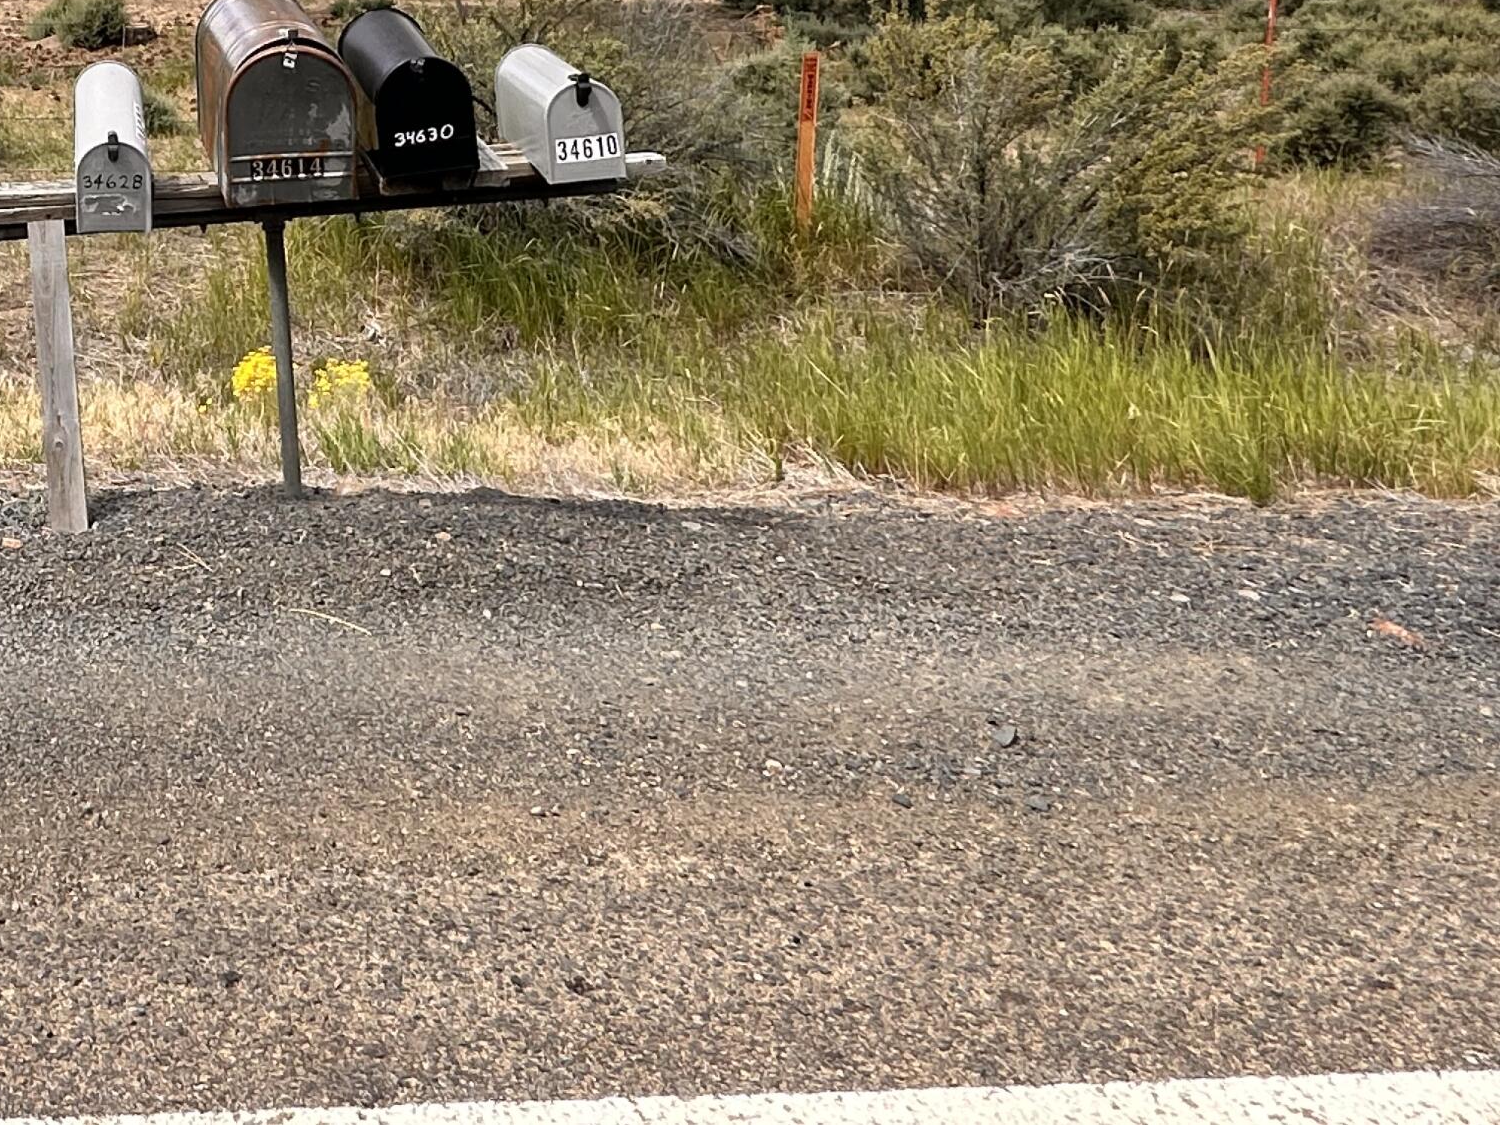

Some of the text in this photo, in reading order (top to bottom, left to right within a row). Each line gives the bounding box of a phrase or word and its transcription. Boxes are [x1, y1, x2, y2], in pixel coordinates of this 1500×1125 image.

[393, 123, 454, 147] 34630
[556, 134, 618, 161] 34610
[252, 158, 322, 181] 34614
[82, 174, 143, 190] 34628
